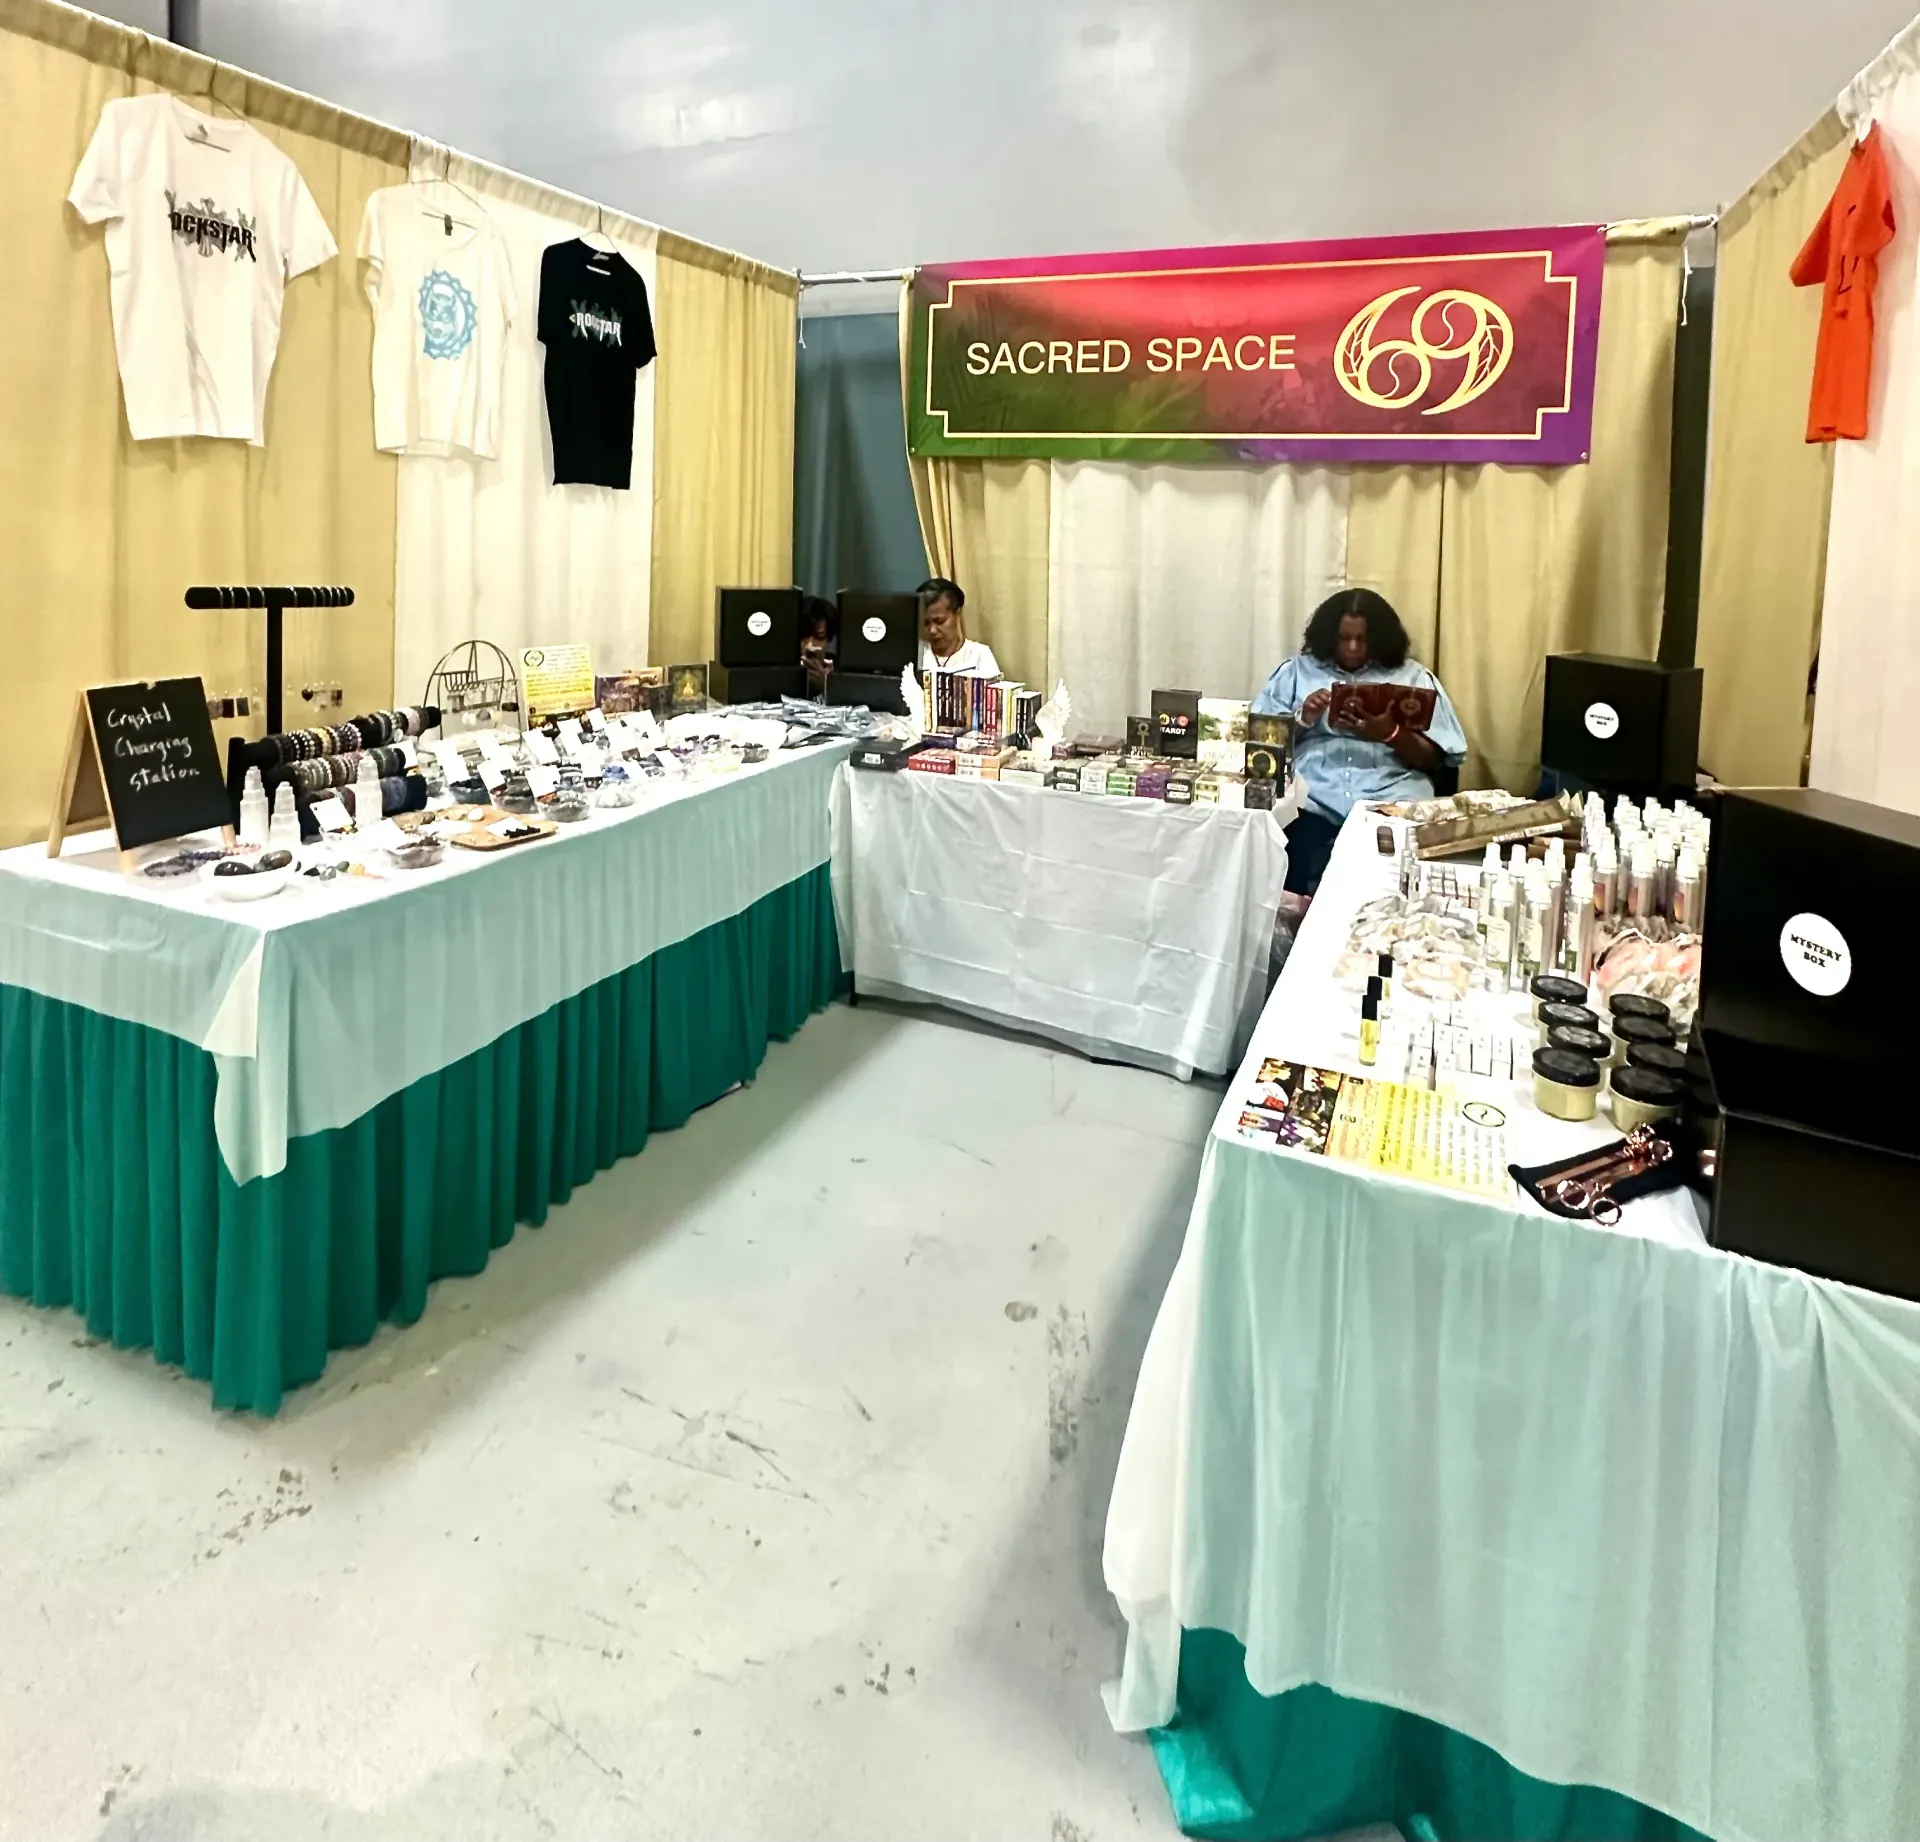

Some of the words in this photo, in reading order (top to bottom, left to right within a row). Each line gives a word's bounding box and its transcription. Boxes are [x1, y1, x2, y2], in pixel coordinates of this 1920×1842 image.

[966, 339, 1131, 375] SACRED
[1146, 334, 1296, 372] SPACE
[1333, 286, 1514, 415] 69
[107, 702, 172, 730] Crystal
[1160, 726, 1187, 736] TAROT
[114, 736, 193, 762] Charging
[1790, 933, 1842, 962] MYSTERY
[1803, 951, 1826, 968] BOX
